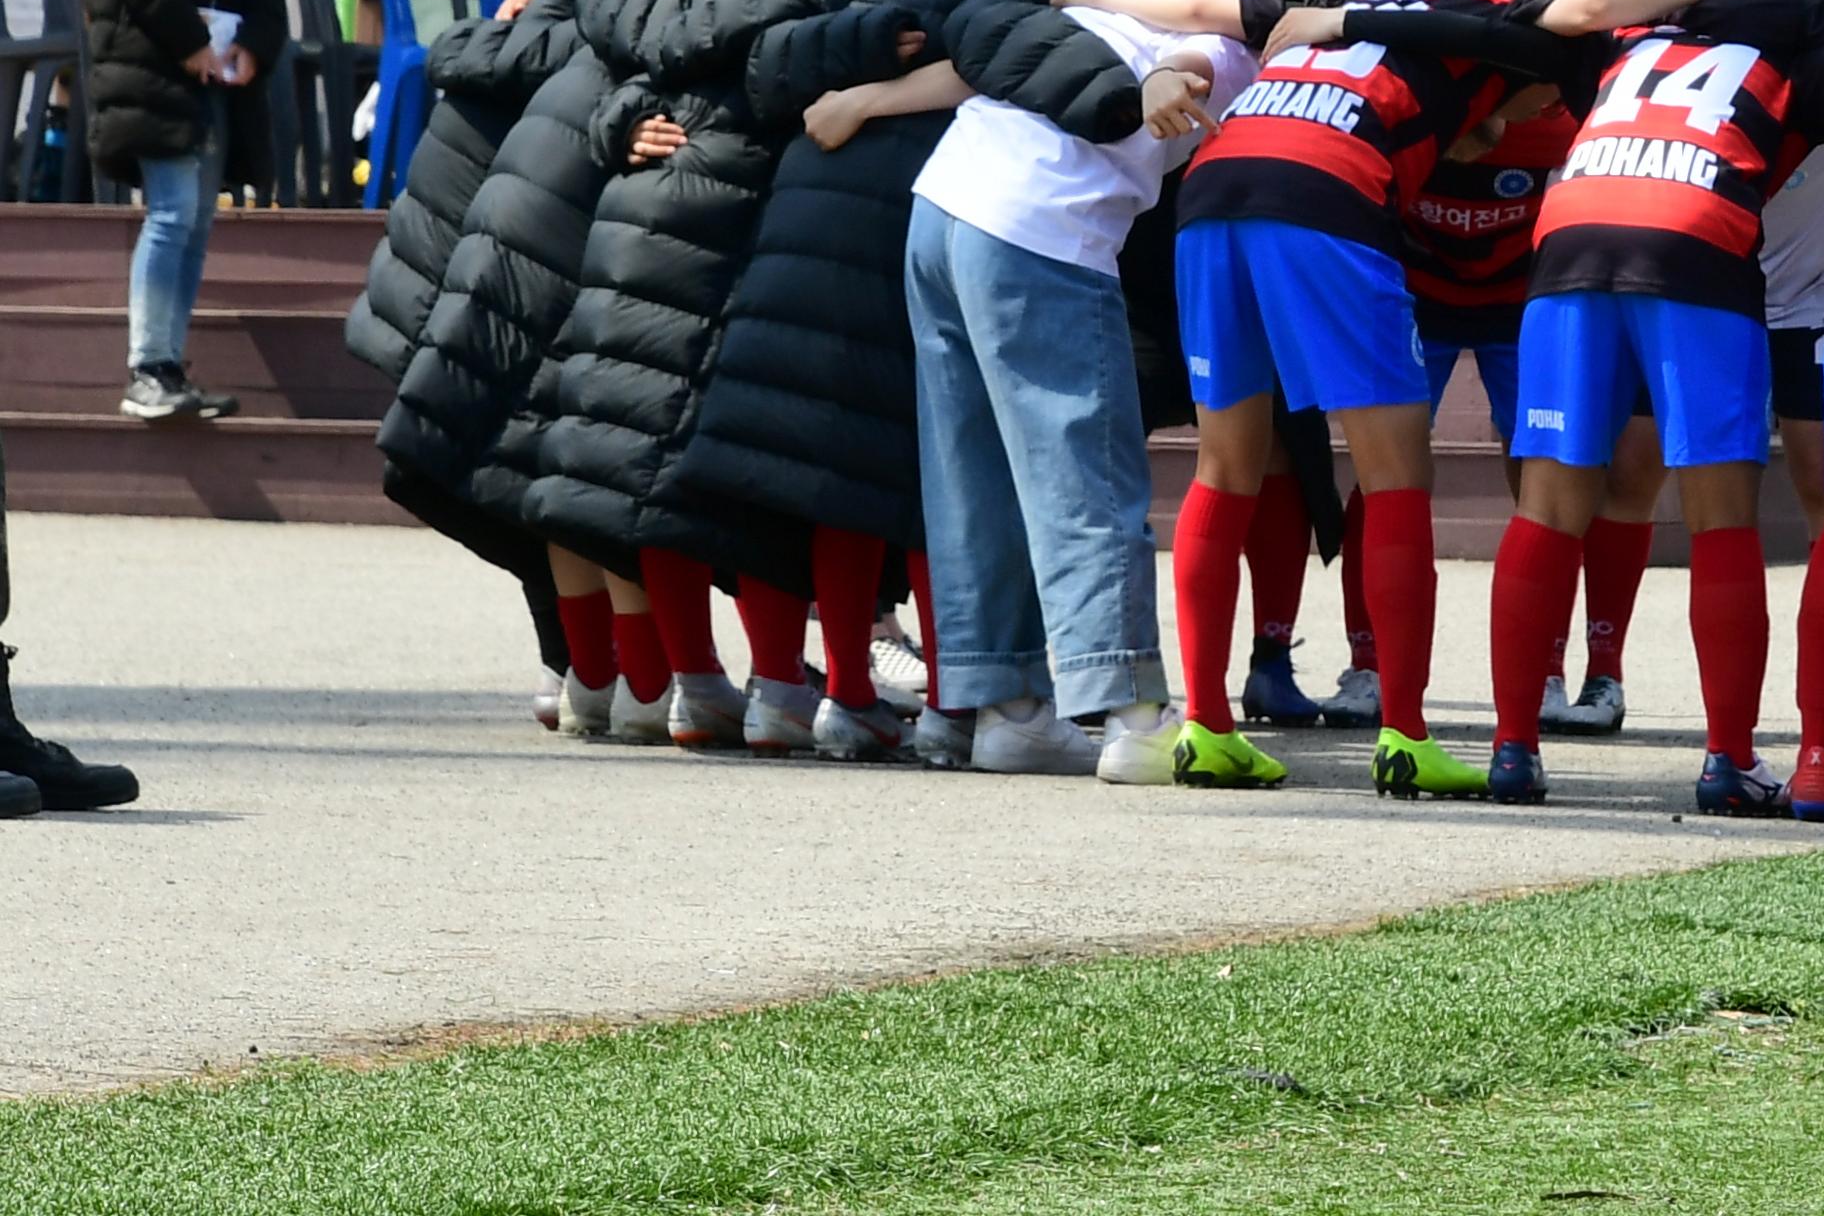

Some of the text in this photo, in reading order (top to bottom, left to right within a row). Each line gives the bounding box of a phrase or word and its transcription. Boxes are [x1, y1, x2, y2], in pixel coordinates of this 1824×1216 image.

[1219, 80, 1365, 134] POHANG
[1590, 38, 1761, 136] 14
[1561, 136, 1719, 191] POHANG
